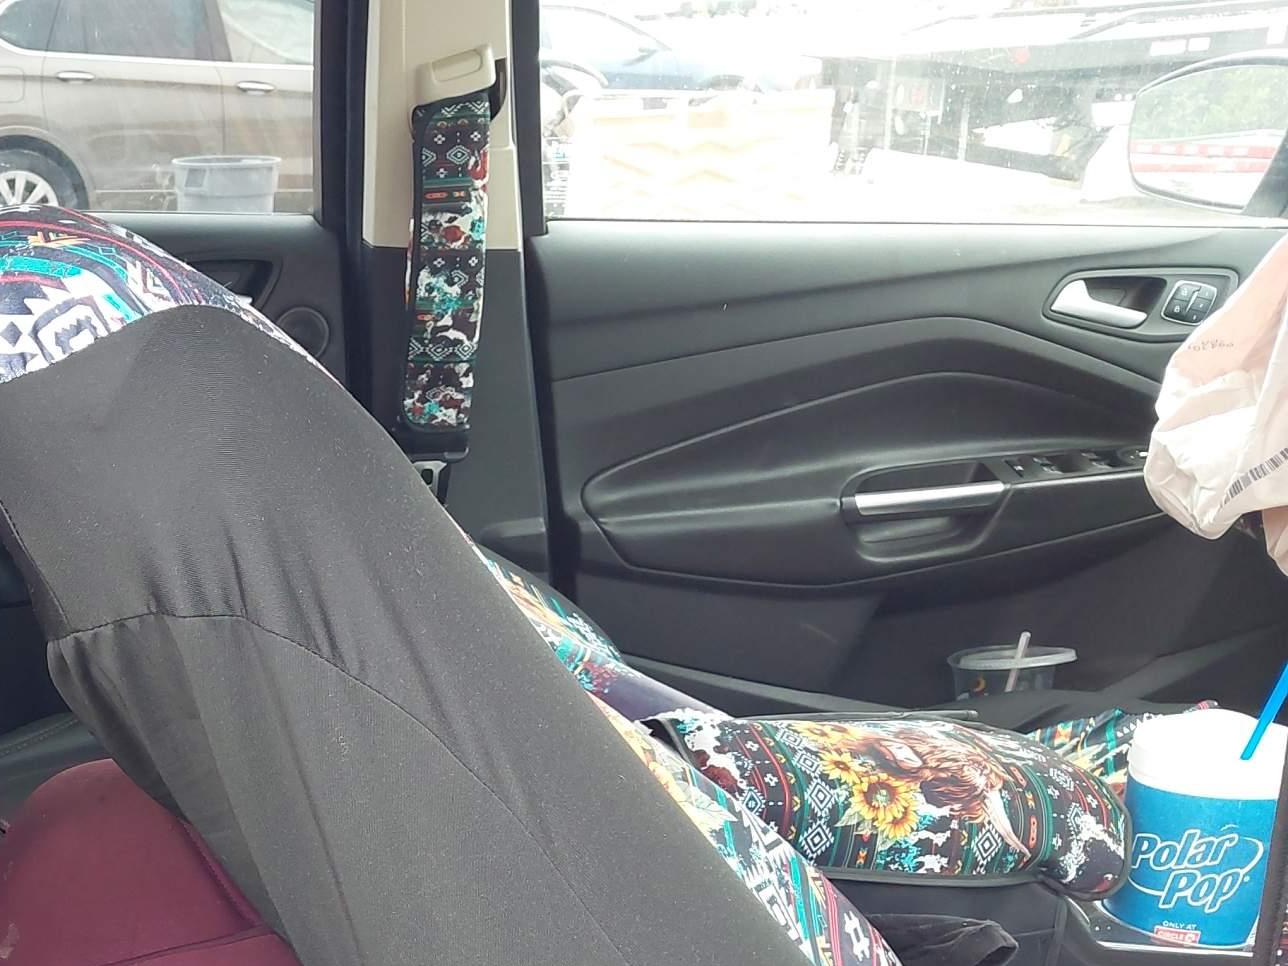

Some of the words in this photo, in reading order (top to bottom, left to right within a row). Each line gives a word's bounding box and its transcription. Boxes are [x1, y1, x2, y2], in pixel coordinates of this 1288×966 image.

[1131, 830, 1239, 870] Polar
[1159, 869, 1243, 913] Pop
[1163, 920, 1184, 929] ONLY
